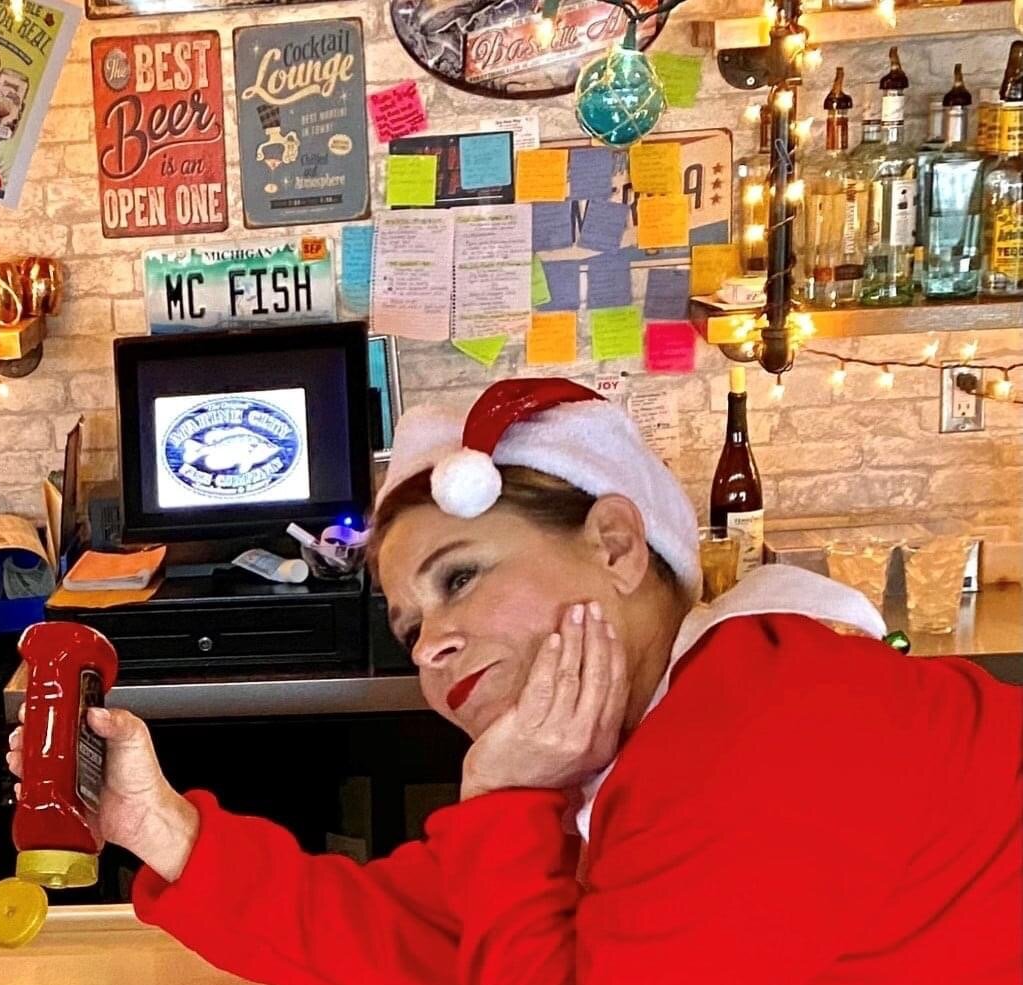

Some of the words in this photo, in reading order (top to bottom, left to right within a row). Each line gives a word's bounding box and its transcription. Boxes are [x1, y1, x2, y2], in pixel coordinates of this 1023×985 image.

[105, 57, 128, 80] The
[134, 39, 211, 92] BEST
[283, 30, 351, 67] Cocktail
[241, 48, 355, 105] Lounge
[101, 90, 222, 181] Beer
[160, 154, 176, 176] is
[180, 159, 206, 176] an
[103, 186, 166, 229] OPEN
[176, 183, 224, 226] ONE
[204, 246, 273, 261] MICHIGAN
[165, 271, 206, 320] MC
[228, 265, 312, 316] FISH
[597, 380, 619, 390] JOY
